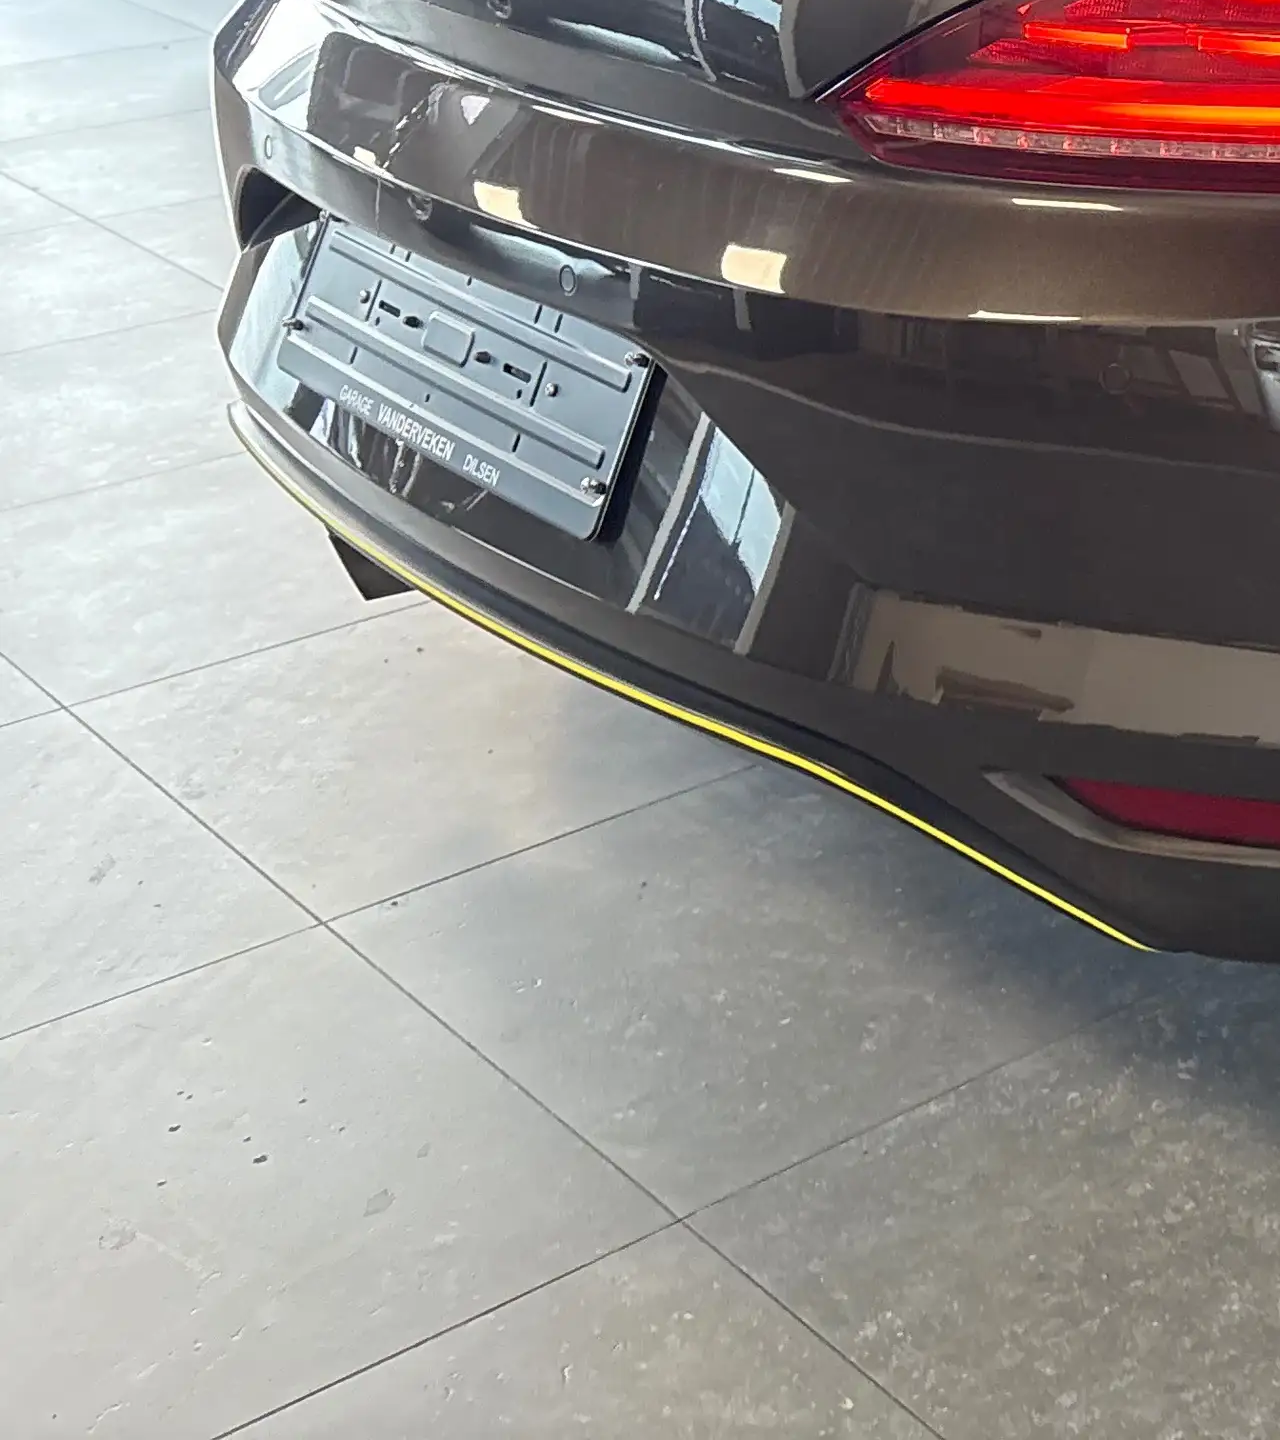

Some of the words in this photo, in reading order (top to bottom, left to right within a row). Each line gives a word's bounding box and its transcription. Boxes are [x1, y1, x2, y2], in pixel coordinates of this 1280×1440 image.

[339, 384, 375, 416] GARAGE
[376, 402, 456, 461] VANDERVEKEN
[462, 453, 501, 487] DILSEN
